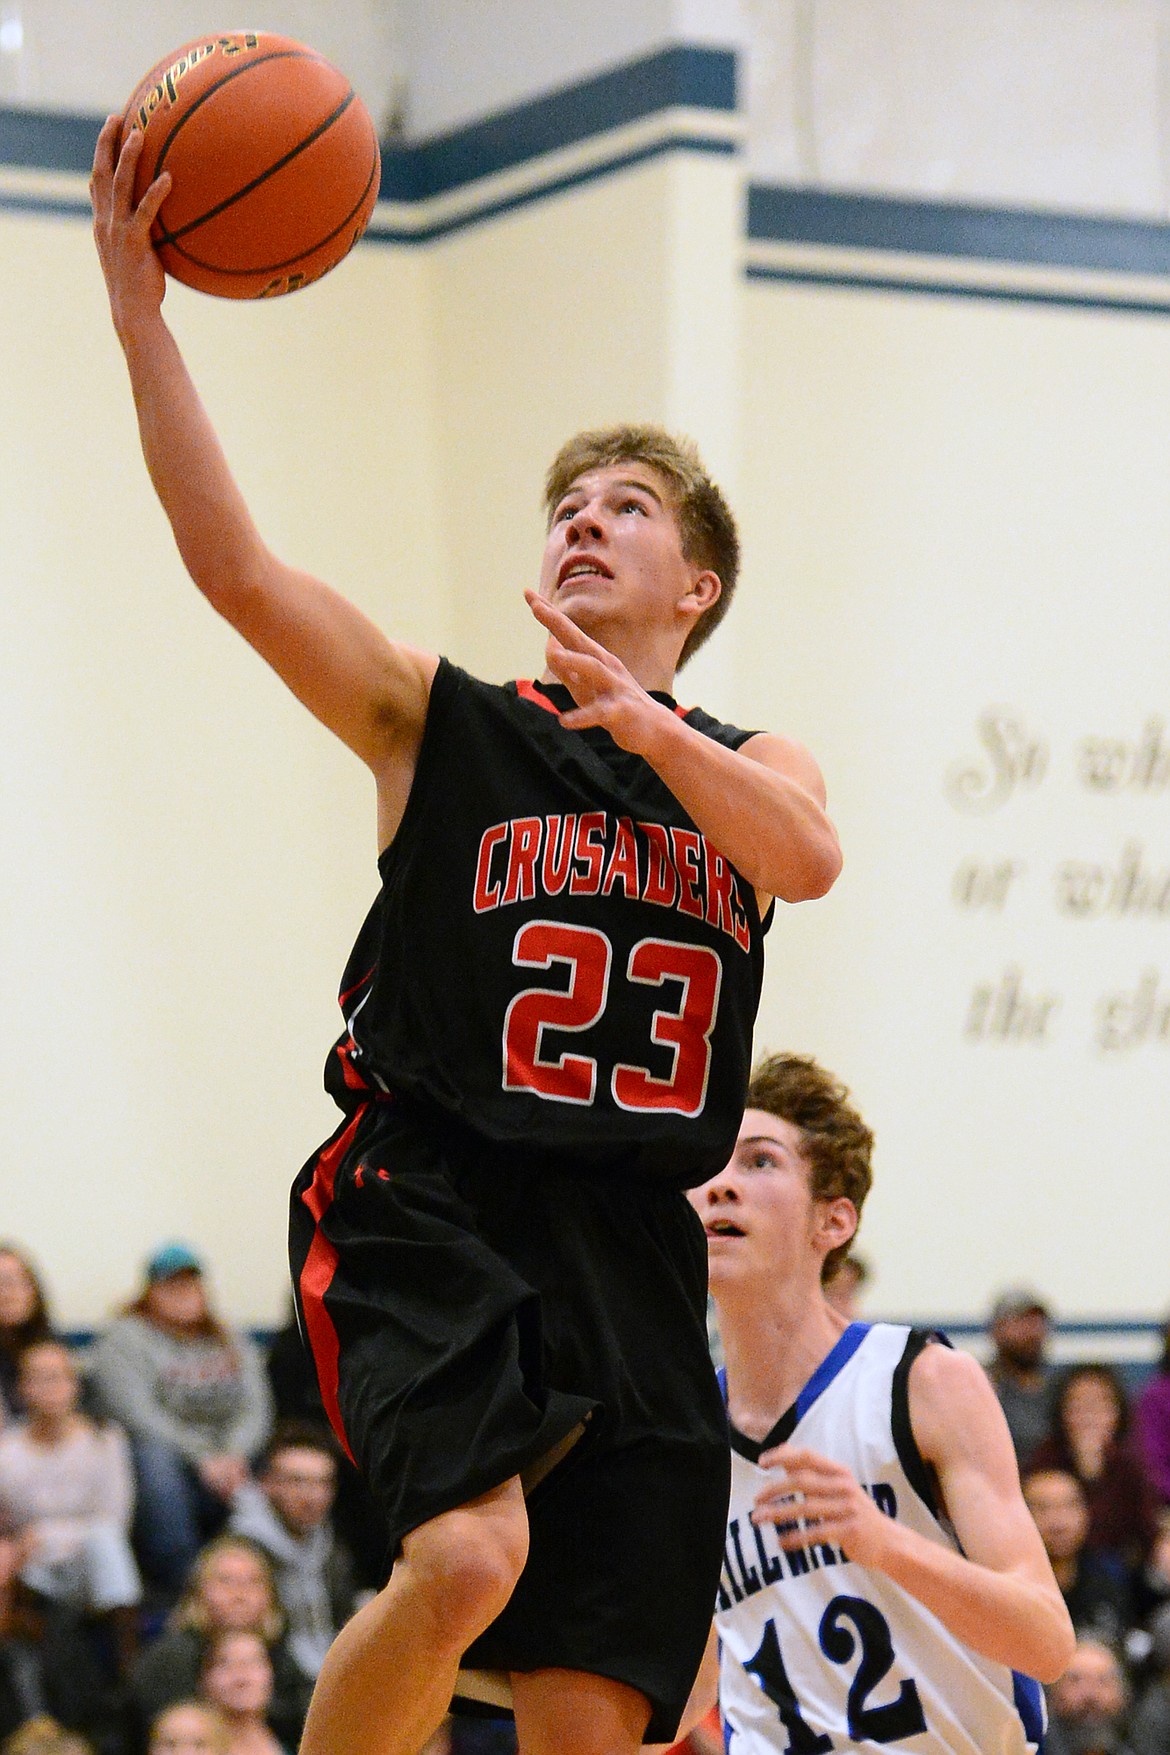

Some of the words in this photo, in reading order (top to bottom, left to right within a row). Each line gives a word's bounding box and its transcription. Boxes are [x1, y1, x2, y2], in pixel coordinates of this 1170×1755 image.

[473, 811, 750, 954] CRUSADERS
[502, 919, 723, 1118] 23
[742, 1595, 928, 1755] 12
